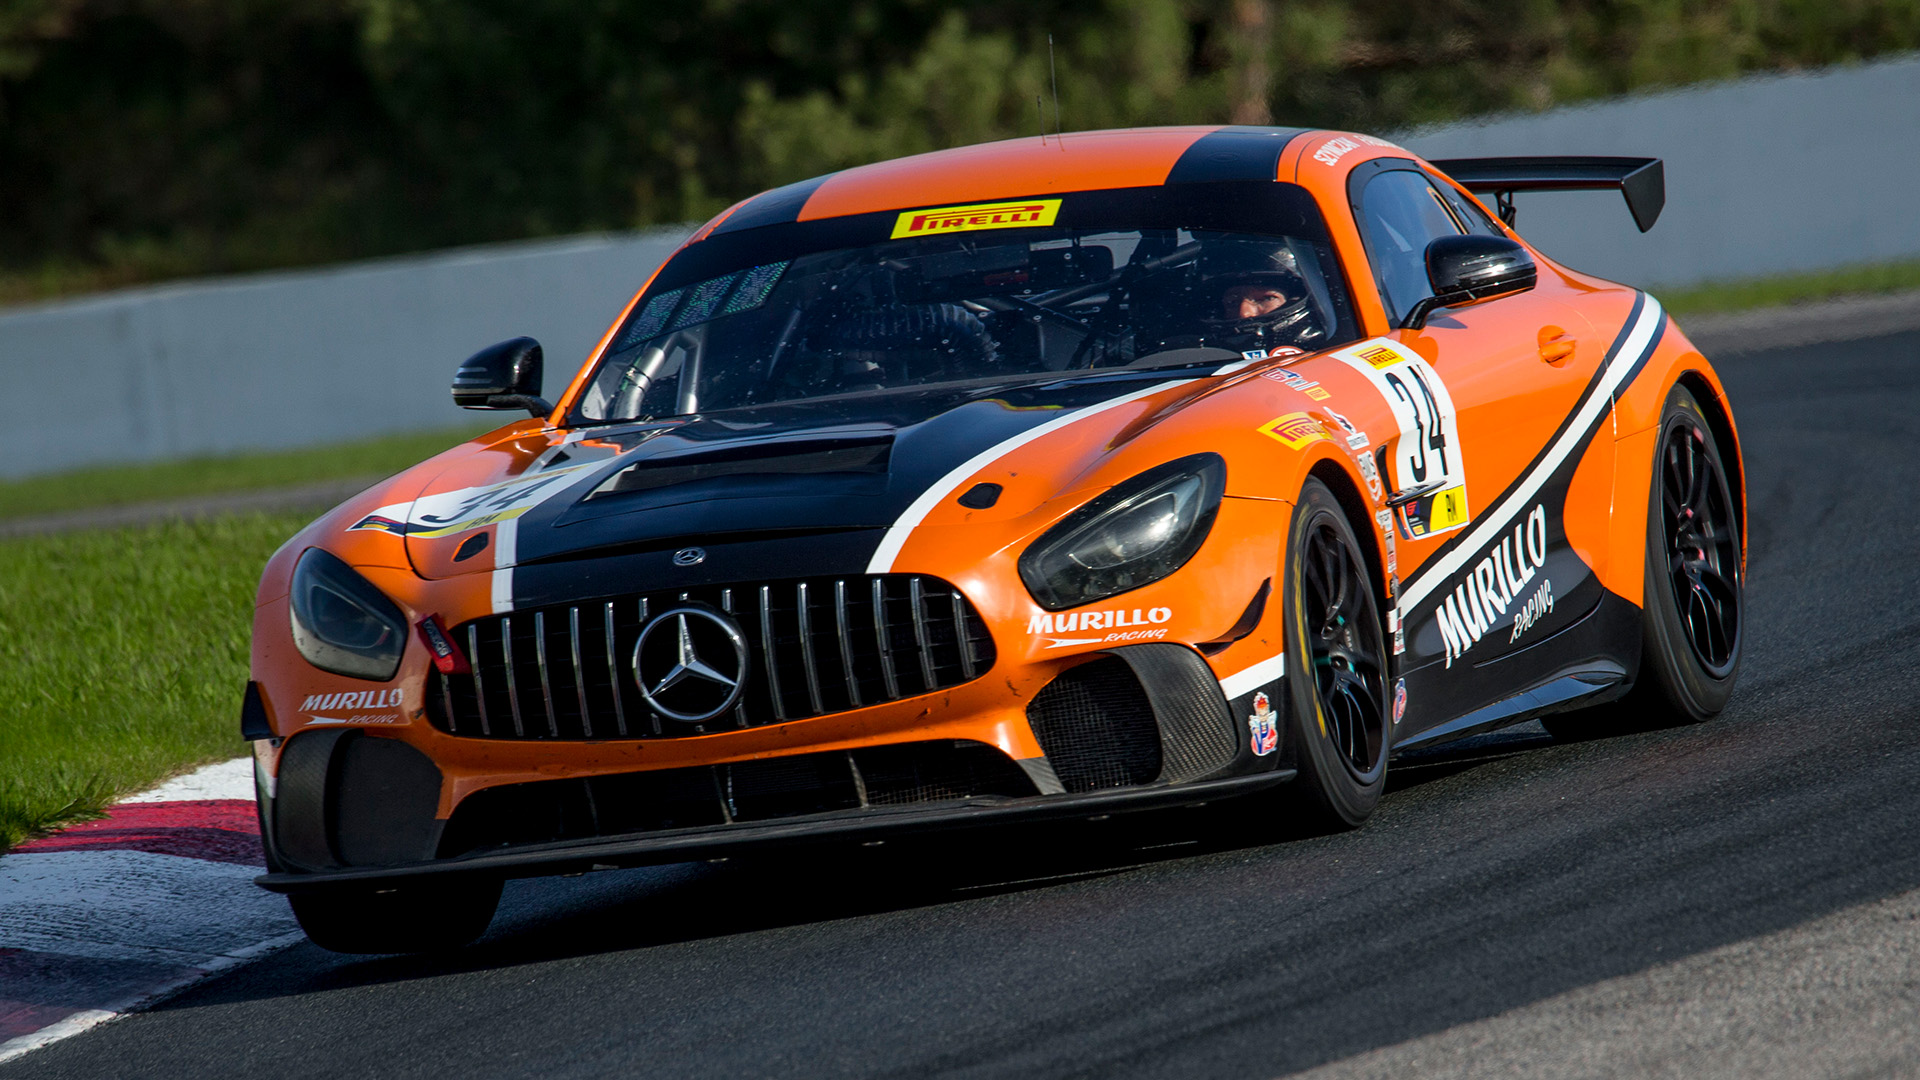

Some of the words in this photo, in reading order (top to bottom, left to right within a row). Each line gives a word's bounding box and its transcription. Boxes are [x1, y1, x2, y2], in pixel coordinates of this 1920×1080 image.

[909, 205, 1045, 232] PIRELLI
[1359, 347, 1397, 366] PIRELLI
[1385, 364, 1448, 483] 34
[420, 475, 568, 523] 34
[1435, 503, 1547, 670] MURILLO
[1027, 607, 1172, 634] MURILLO
[1509, 579, 1554, 644] RACING
[1103, 629, 1168, 643] RACING
[298, 688, 404, 712] MURILLO
[346, 714, 399, 725] RACING
